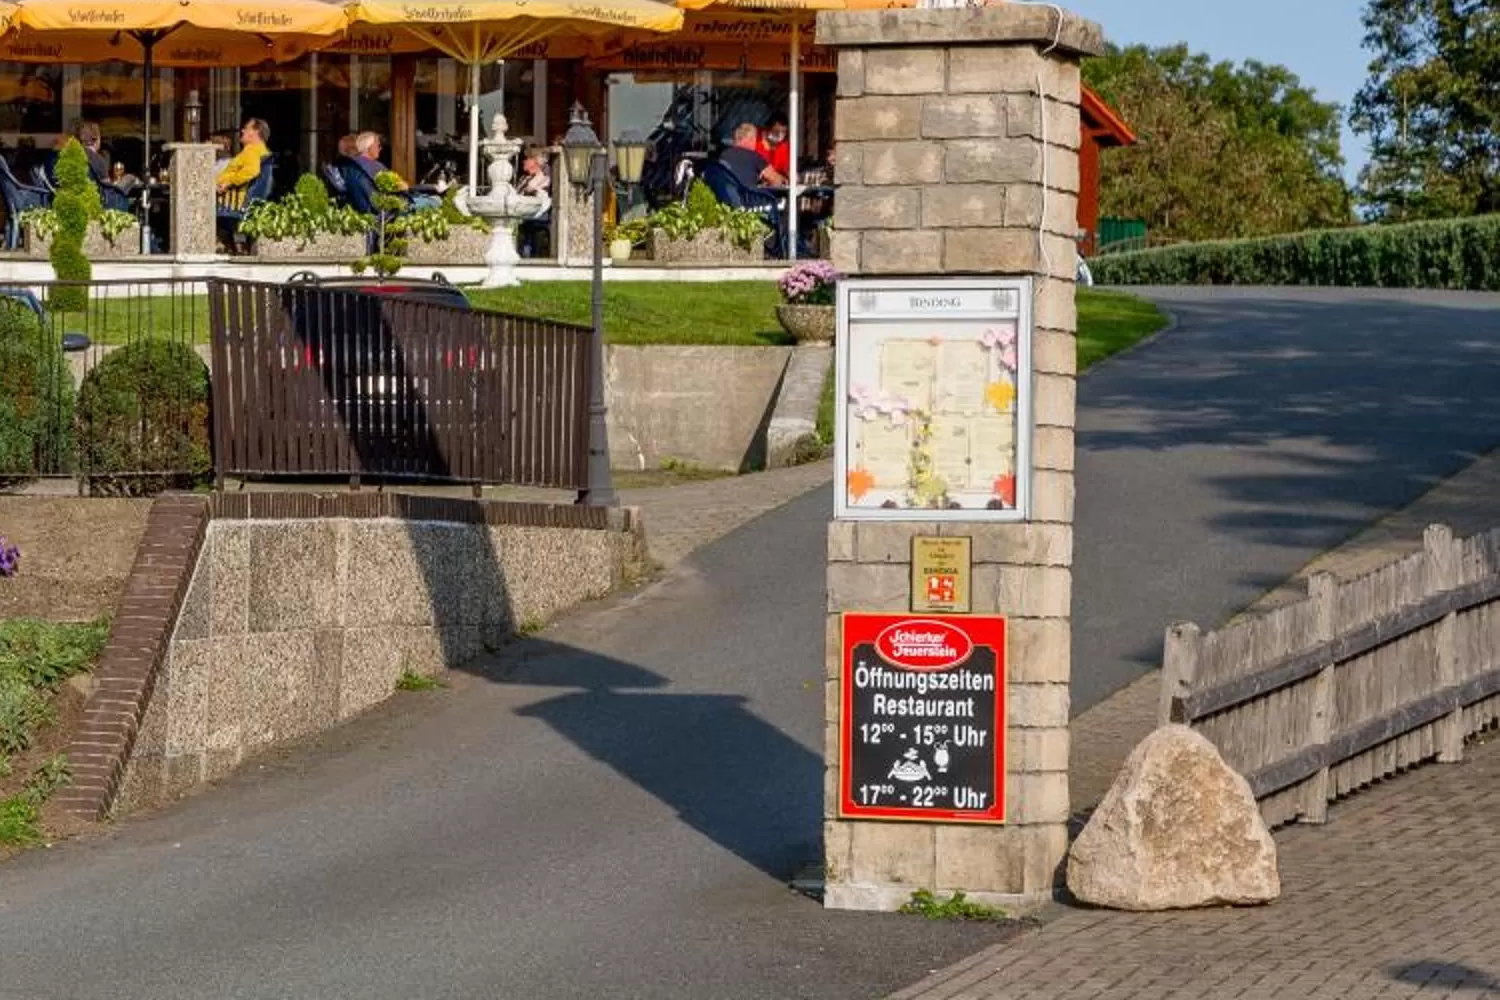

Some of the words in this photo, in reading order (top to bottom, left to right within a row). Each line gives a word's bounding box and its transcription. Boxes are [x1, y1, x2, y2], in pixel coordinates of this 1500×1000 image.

[888, 630, 948, 643] Schierker
[855, 661, 993, 694] Öffnungszeiten
[873, 693, 974, 717] Restaurant
[953, 725, 987, 746] Uhr
[953, 787, 987, 809] Uhr
